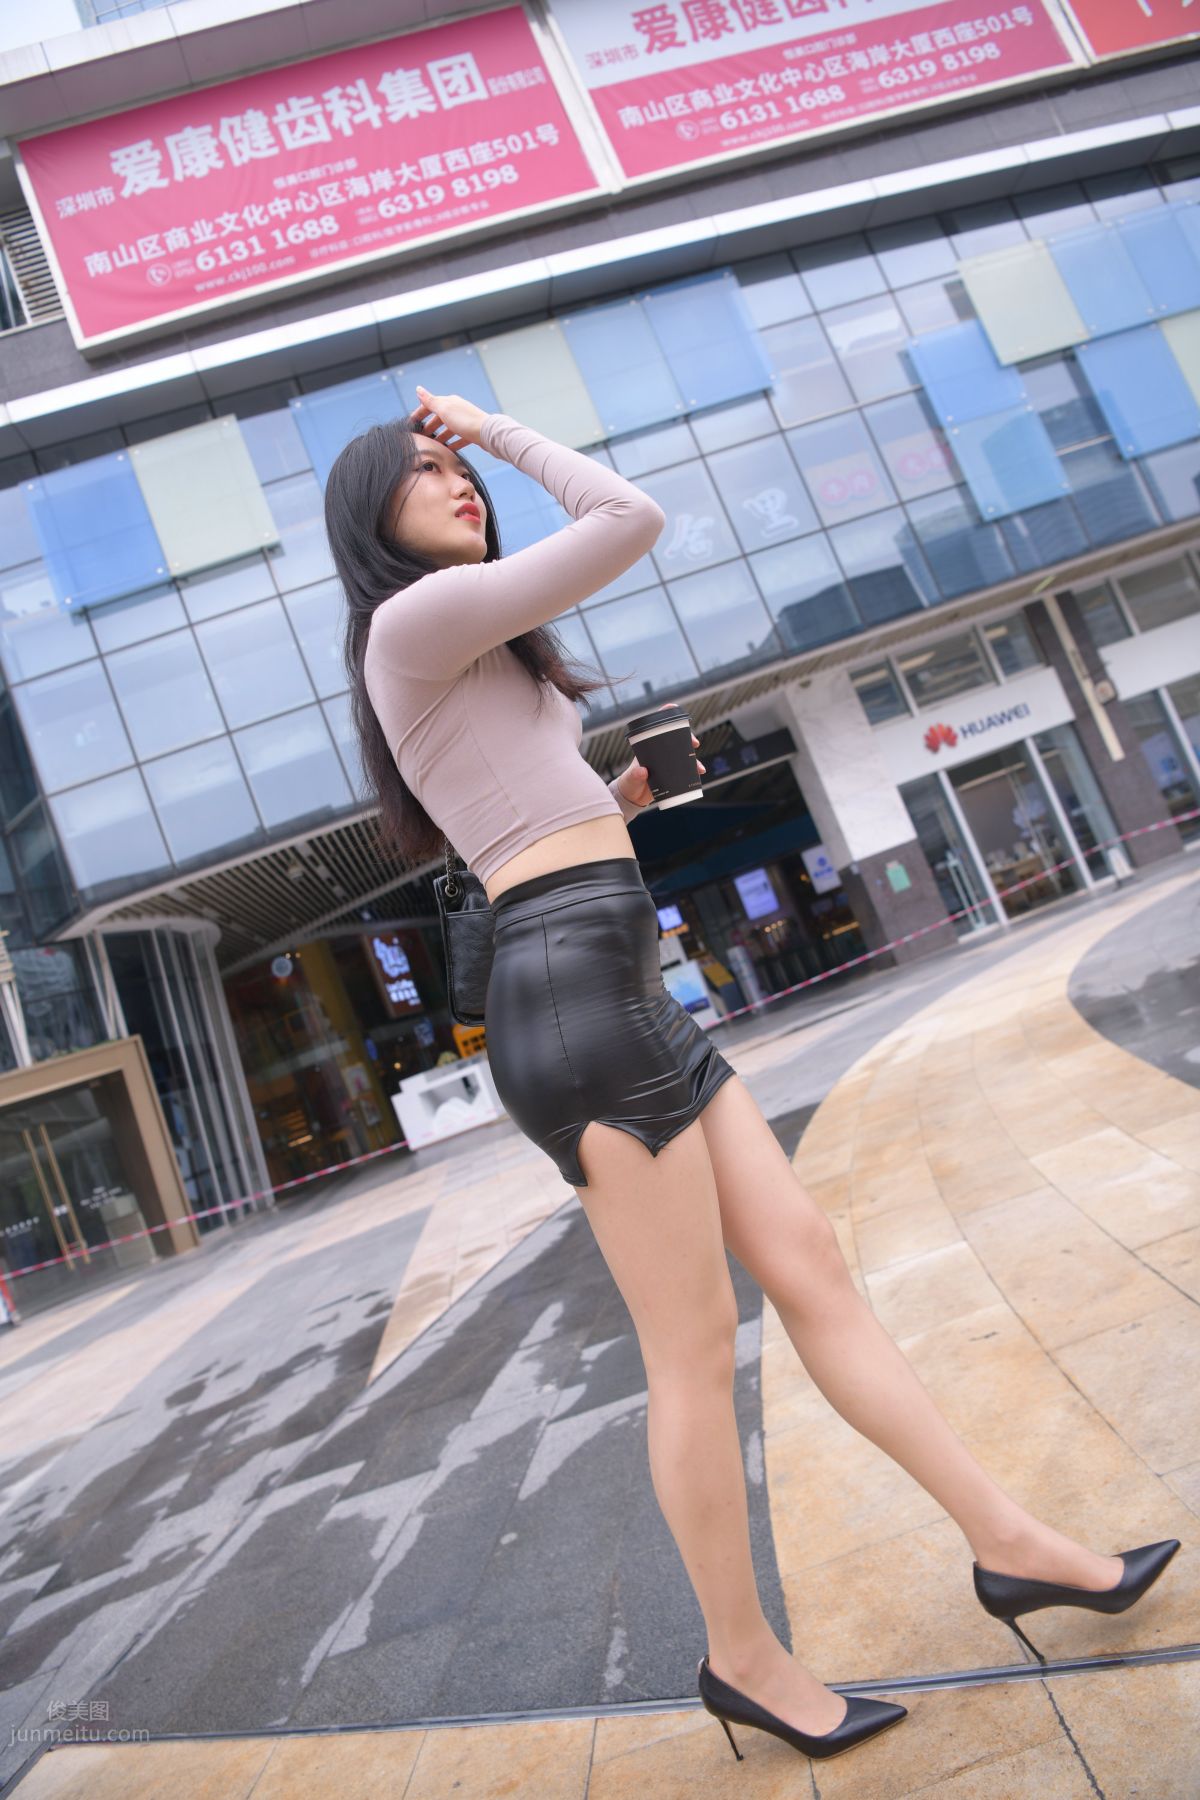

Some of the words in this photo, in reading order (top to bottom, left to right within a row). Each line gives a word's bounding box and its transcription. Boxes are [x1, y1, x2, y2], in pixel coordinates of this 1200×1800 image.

[584, 43, 640, 69] 深圳市
[617, 6, 1034, 129] 南山区商业文化中心区海岸大厦西座501号
[720, 101, 782, 130] 6131
[786, 84, 847, 114] 1688
[878, 60, 937, 89] 6319
[941, 42, 1002, 71] 8198
[55, 185, 116, 219] 深圳市
[109, 51, 490, 199] 爱康健齿科集团
[83, 122, 560, 278] 南山区商业文化中心区海岸大厦西座501号
[195, 235, 266, 272] 6131
[271, 214, 340, 250] 1688
[377, 184, 446, 219] 6319
[450, 164, 520, 199] 8198
[960, 702, 1031, 739] HUAWEI
